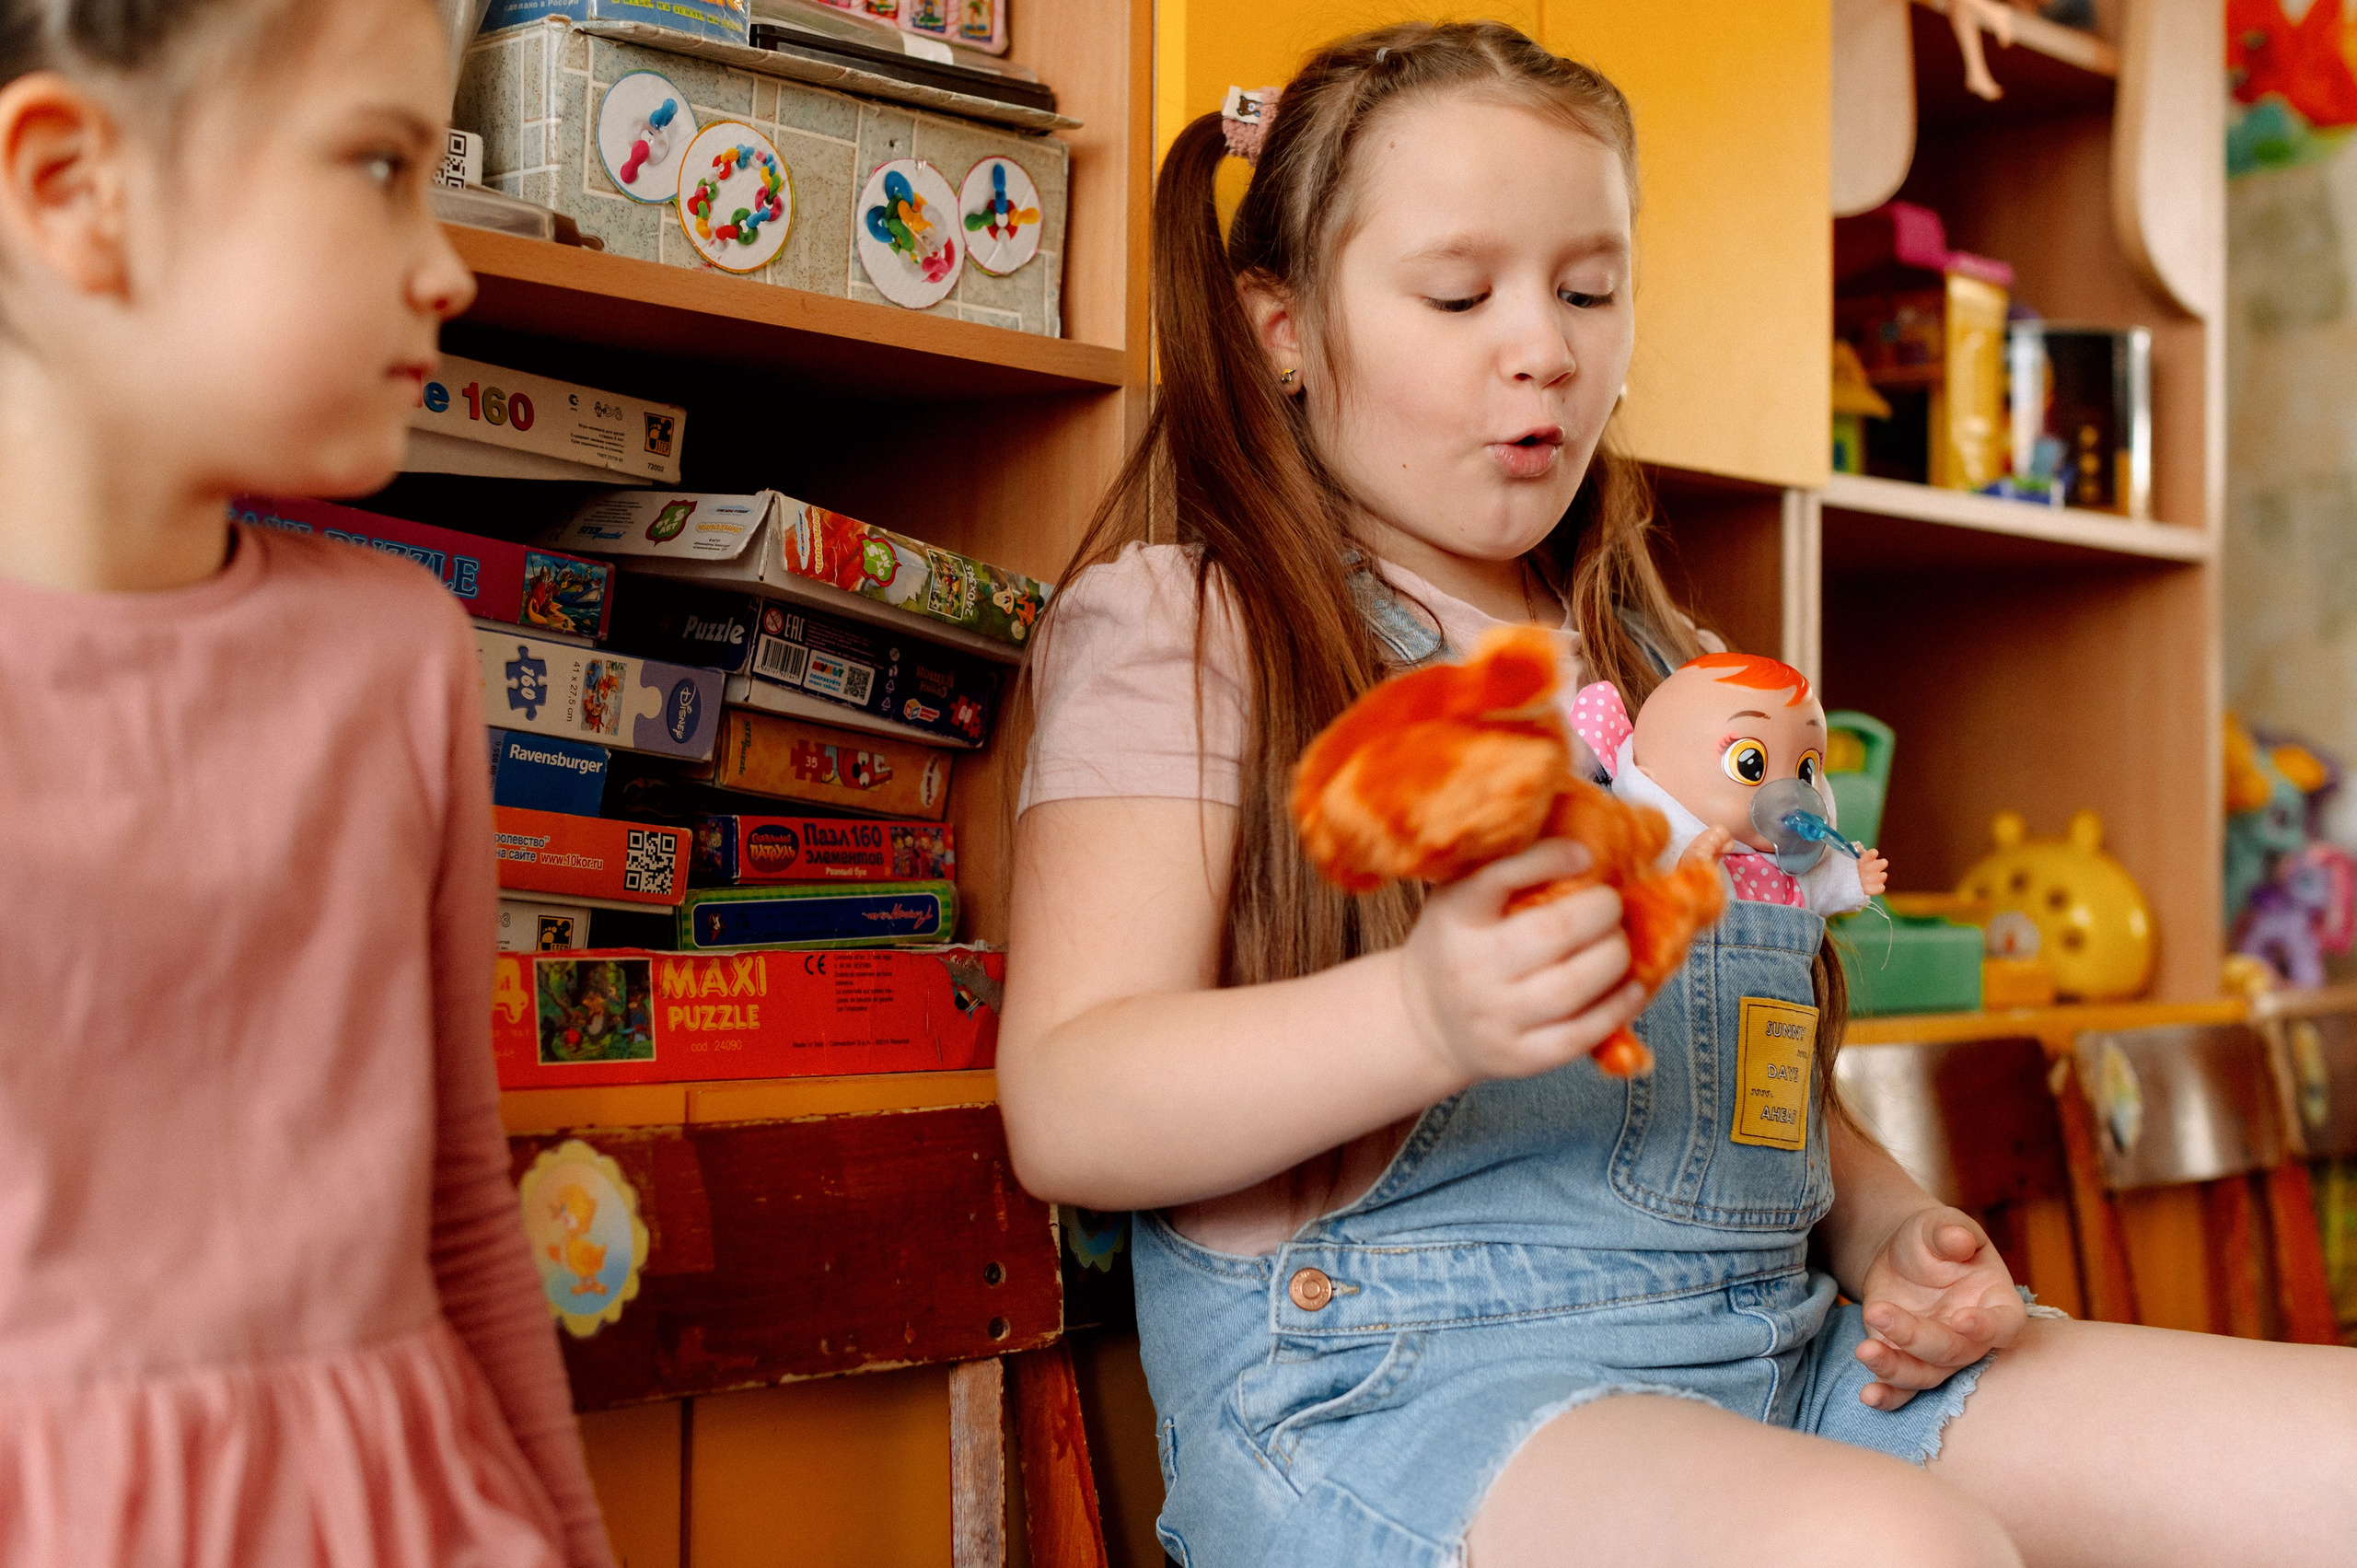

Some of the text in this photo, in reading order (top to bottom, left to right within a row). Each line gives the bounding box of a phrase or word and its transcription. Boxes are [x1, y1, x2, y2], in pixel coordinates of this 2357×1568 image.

[462, 380, 535, 432] 160
[647, 462, 665, 472] 72002
[656, 517, 670, 529] ОТ
[659, 520, 679, 536] ЛЕТ
[681, 613, 745, 645] Puzzle
[573, 661, 581, 673] 41
[520, 665, 536, 700] 160
[567, 684, 578, 705] 27,5
[565, 707, 574, 722] cm
[509, 744, 603, 774] Ravensburger
[805, 756, 818, 769] 35
[803, 823, 883, 848] Пазл 160
[508, 848, 537, 862] сайте
[540, 853, 603, 870] www.10kor.ru
[749, 843, 796, 862] ПАТРУЛЬ
[659, 955, 768, 999] MAXI
[668, 1004, 761, 1032] PUZZLE
[1766, 1020, 1807, 1041] SUNNY
[691, 1039, 742, 1052] cod 24090
[1767, 1063, 1800, 1083] DAYS
